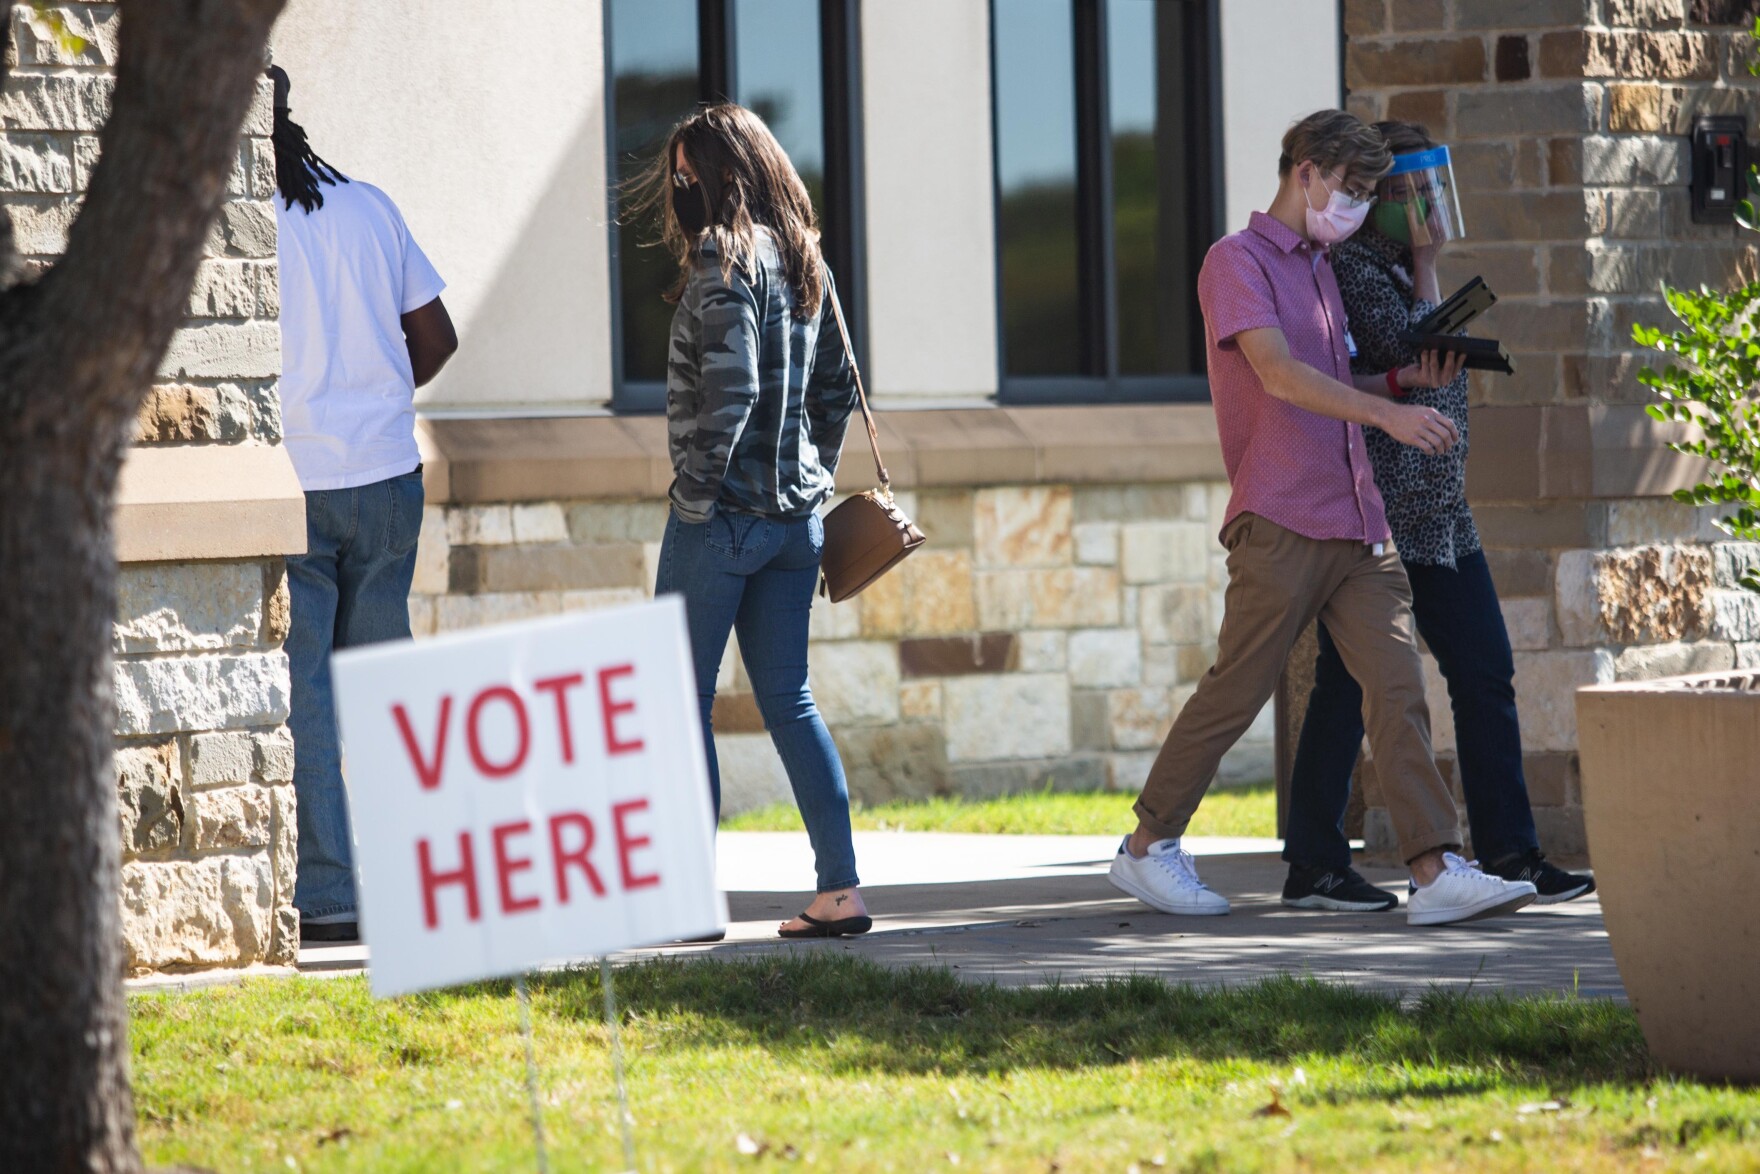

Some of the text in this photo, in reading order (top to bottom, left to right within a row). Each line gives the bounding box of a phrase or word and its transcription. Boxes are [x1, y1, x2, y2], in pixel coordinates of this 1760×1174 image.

[391, 663, 645, 790] VOTE
[416, 798, 661, 930] HERE
[1314, 872, 1344, 893] N
